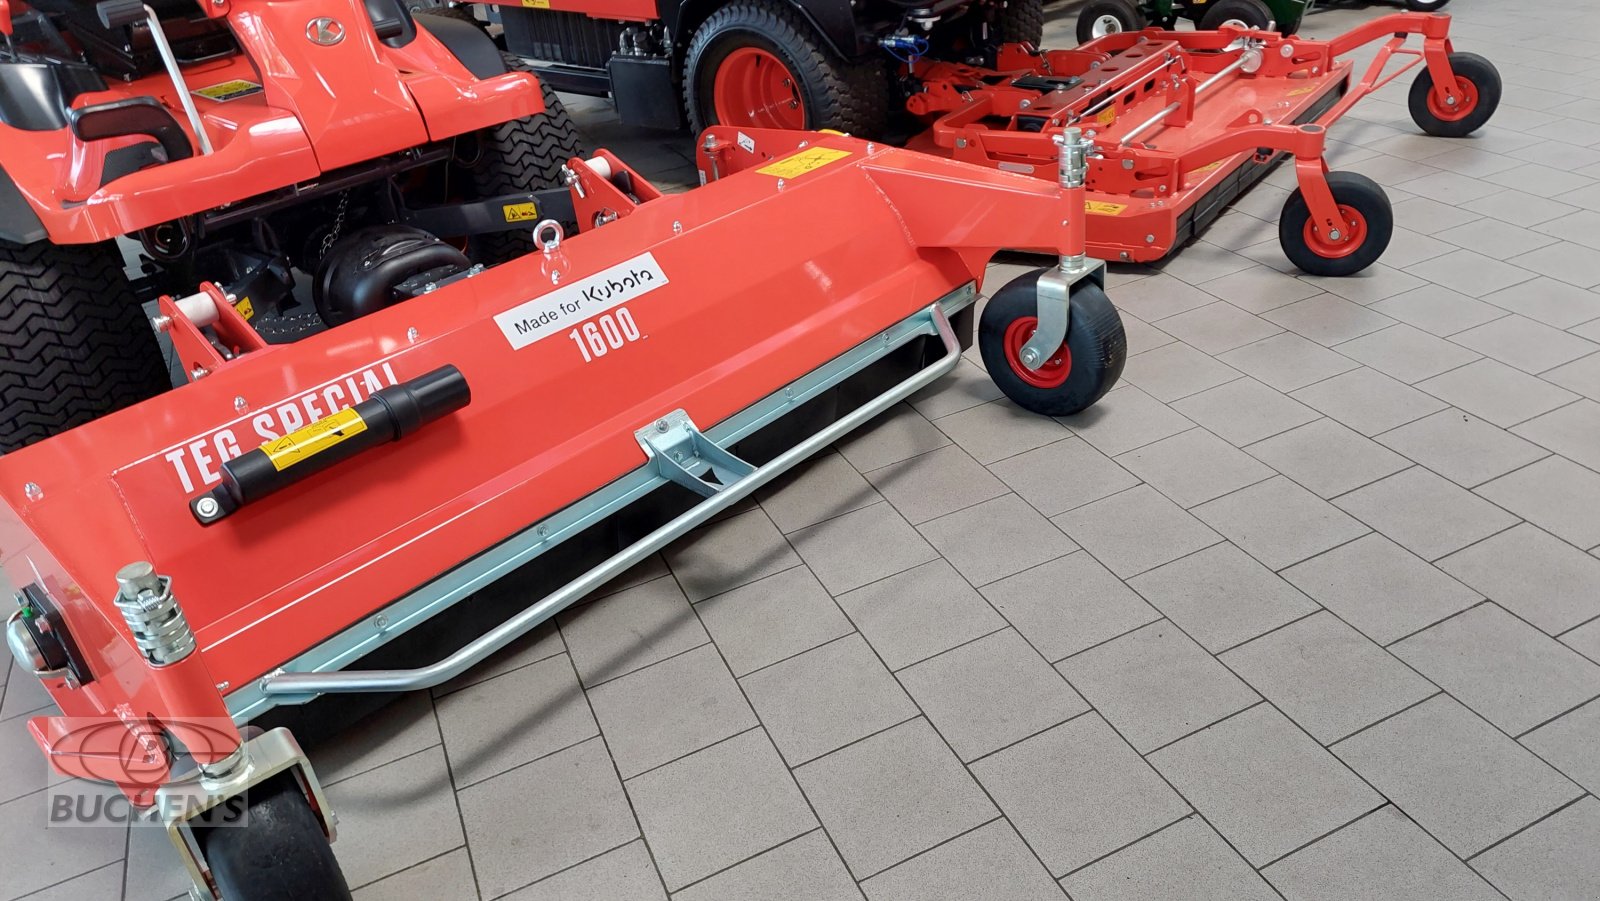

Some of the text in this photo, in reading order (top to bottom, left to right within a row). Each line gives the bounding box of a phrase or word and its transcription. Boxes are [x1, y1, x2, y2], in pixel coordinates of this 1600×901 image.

[514, 269, 653, 335] Made for Kubota
[569, 306, 640, 363] 1600
[165, 429, 242, 494] TEG
